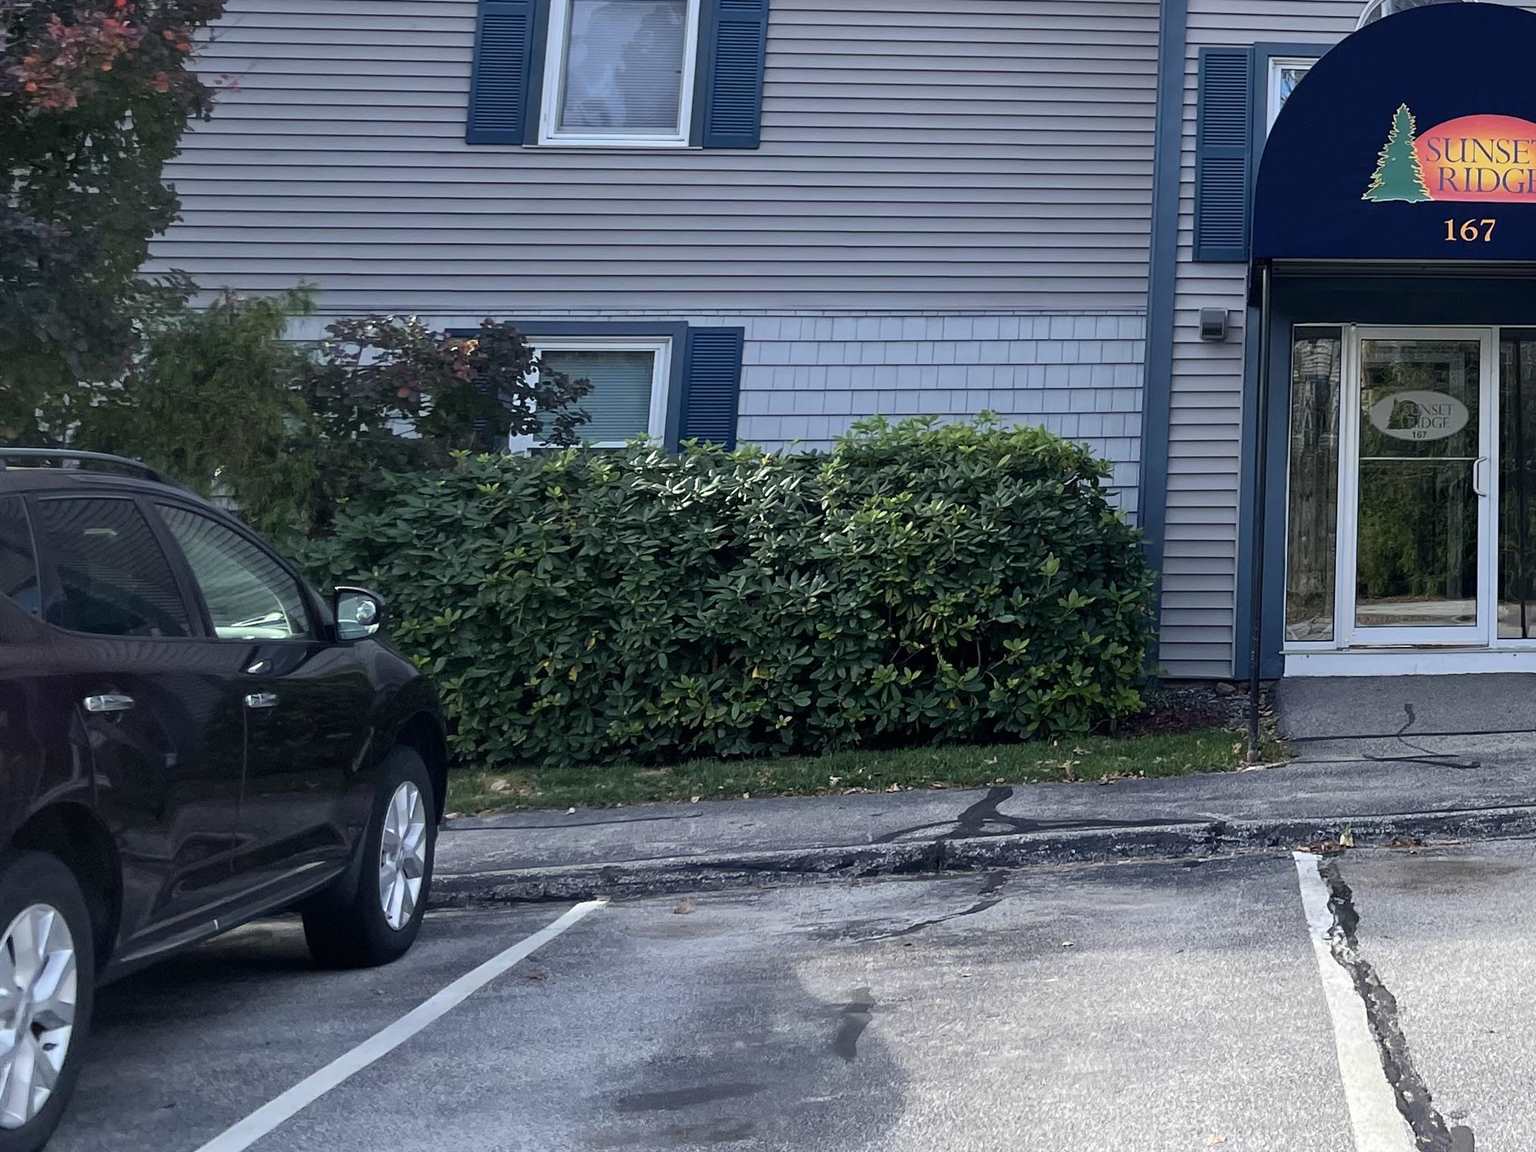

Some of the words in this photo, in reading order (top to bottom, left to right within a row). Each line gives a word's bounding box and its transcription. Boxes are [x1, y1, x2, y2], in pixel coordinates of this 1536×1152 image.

[1444, 218, 1496, 242] 167
[1403, 403, 1455, 416] NSET
[1405, 416, 1449, 429] IDGE
